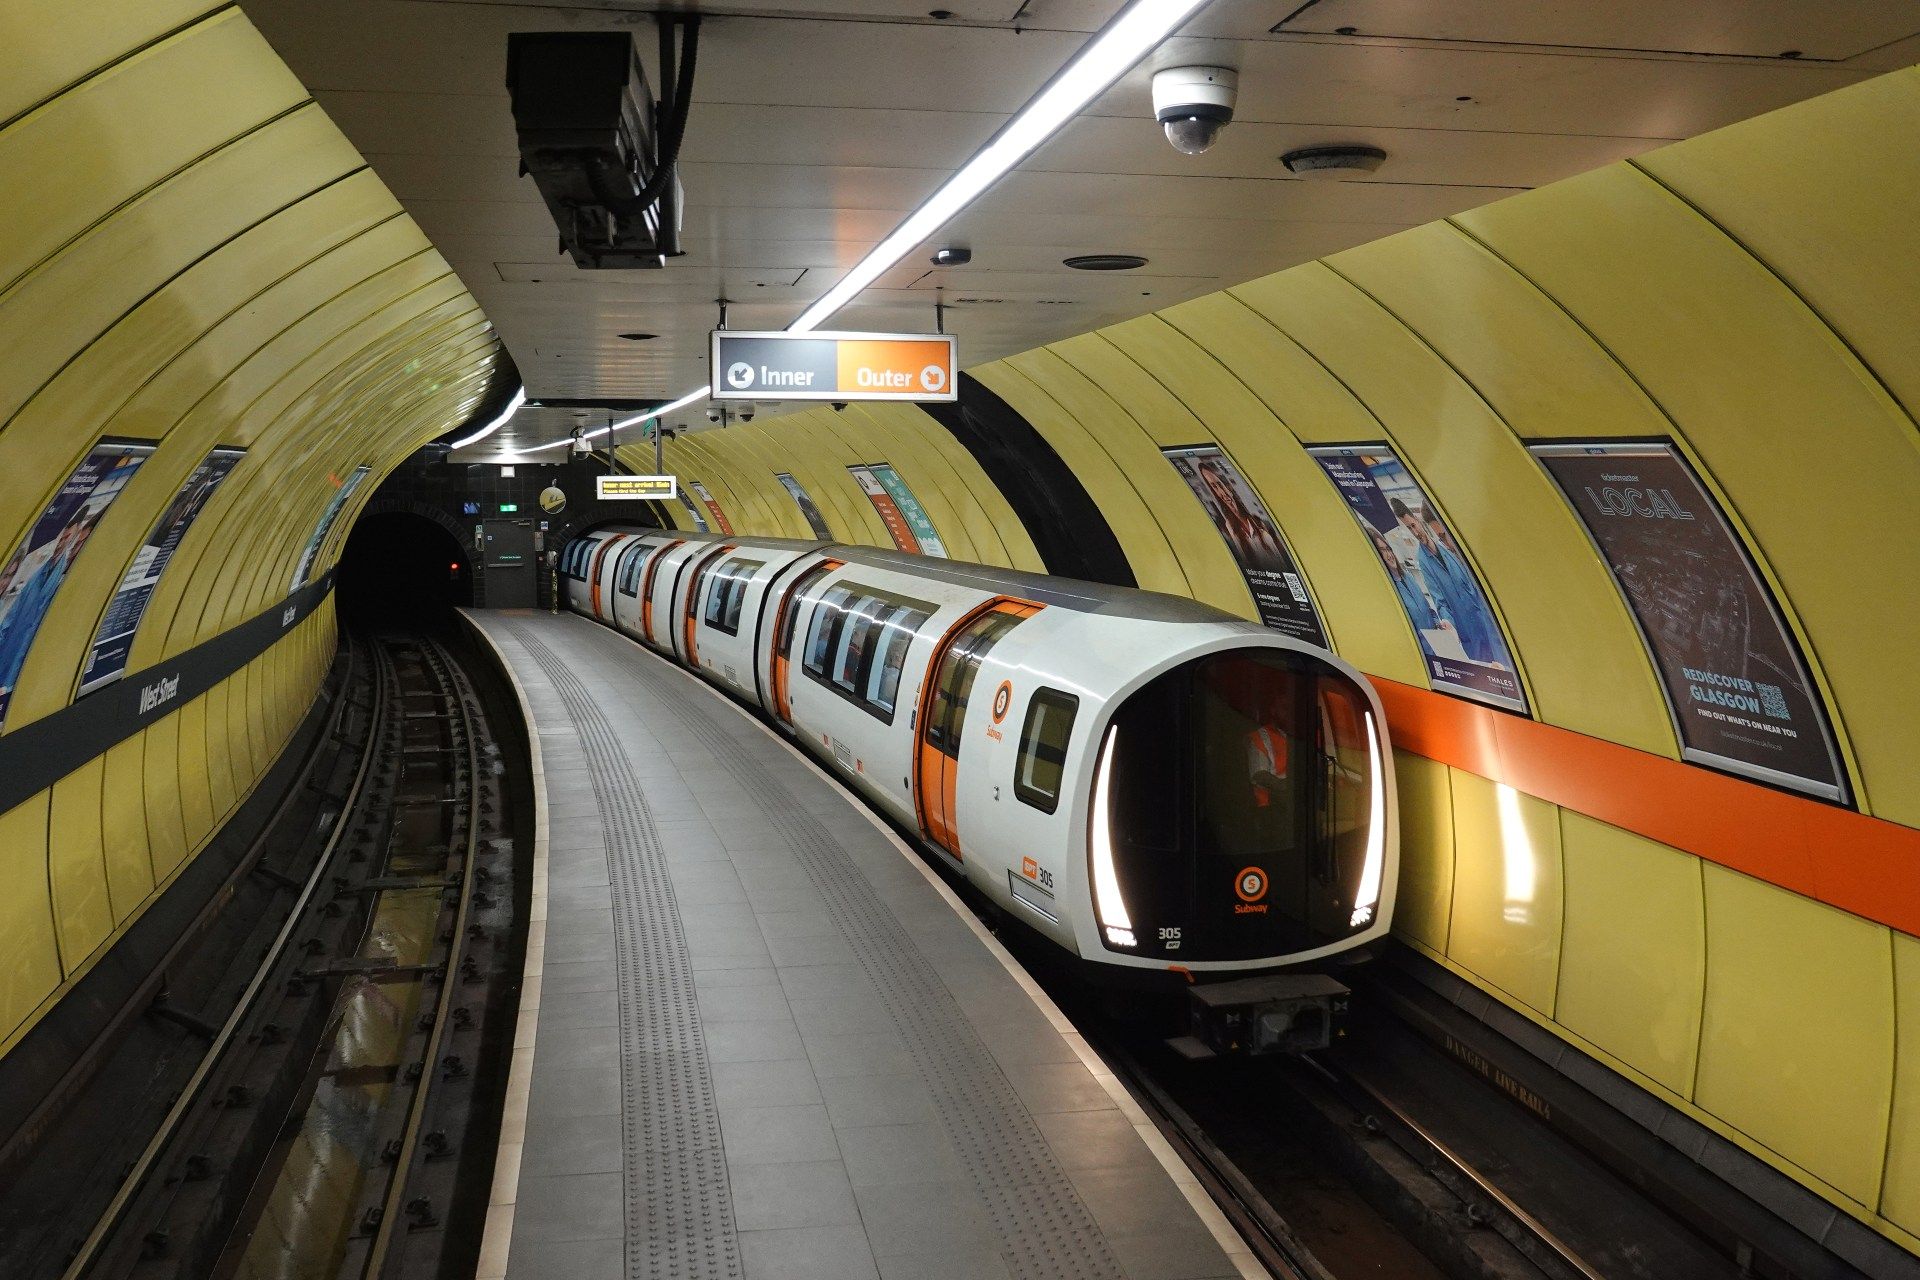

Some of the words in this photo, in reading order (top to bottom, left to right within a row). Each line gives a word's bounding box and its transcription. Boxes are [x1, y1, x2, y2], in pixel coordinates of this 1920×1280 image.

[761, 365, 814, 386] Inner
[857, 367, 912, 388] Outer
[1584, 486, 1696, 521] LOCAL
[1487, 675, 1513, 687] THALES
[1682, 667, 1755, 693] REDISCOVER
[139, 683, 161, 715] West
[157, 672, 180, 705] Street
[1689, 684, 1761, 715] GLASGOW
[1697, 708, 1713, 719] FIND
[1713, 711, 1727, 722] OUT
[1726, 714, 1752, 728] WHAT'S
[1751, 721, 1763, 731] ON
[1762, 723, 1782, 735] NEAR
[1781, 727, 1798, 739] YOU
[1039, 867, 1054, 888] 305
[1234, 903, 1268, 914] Subway
[1158, 927, 1182, 940] 305
